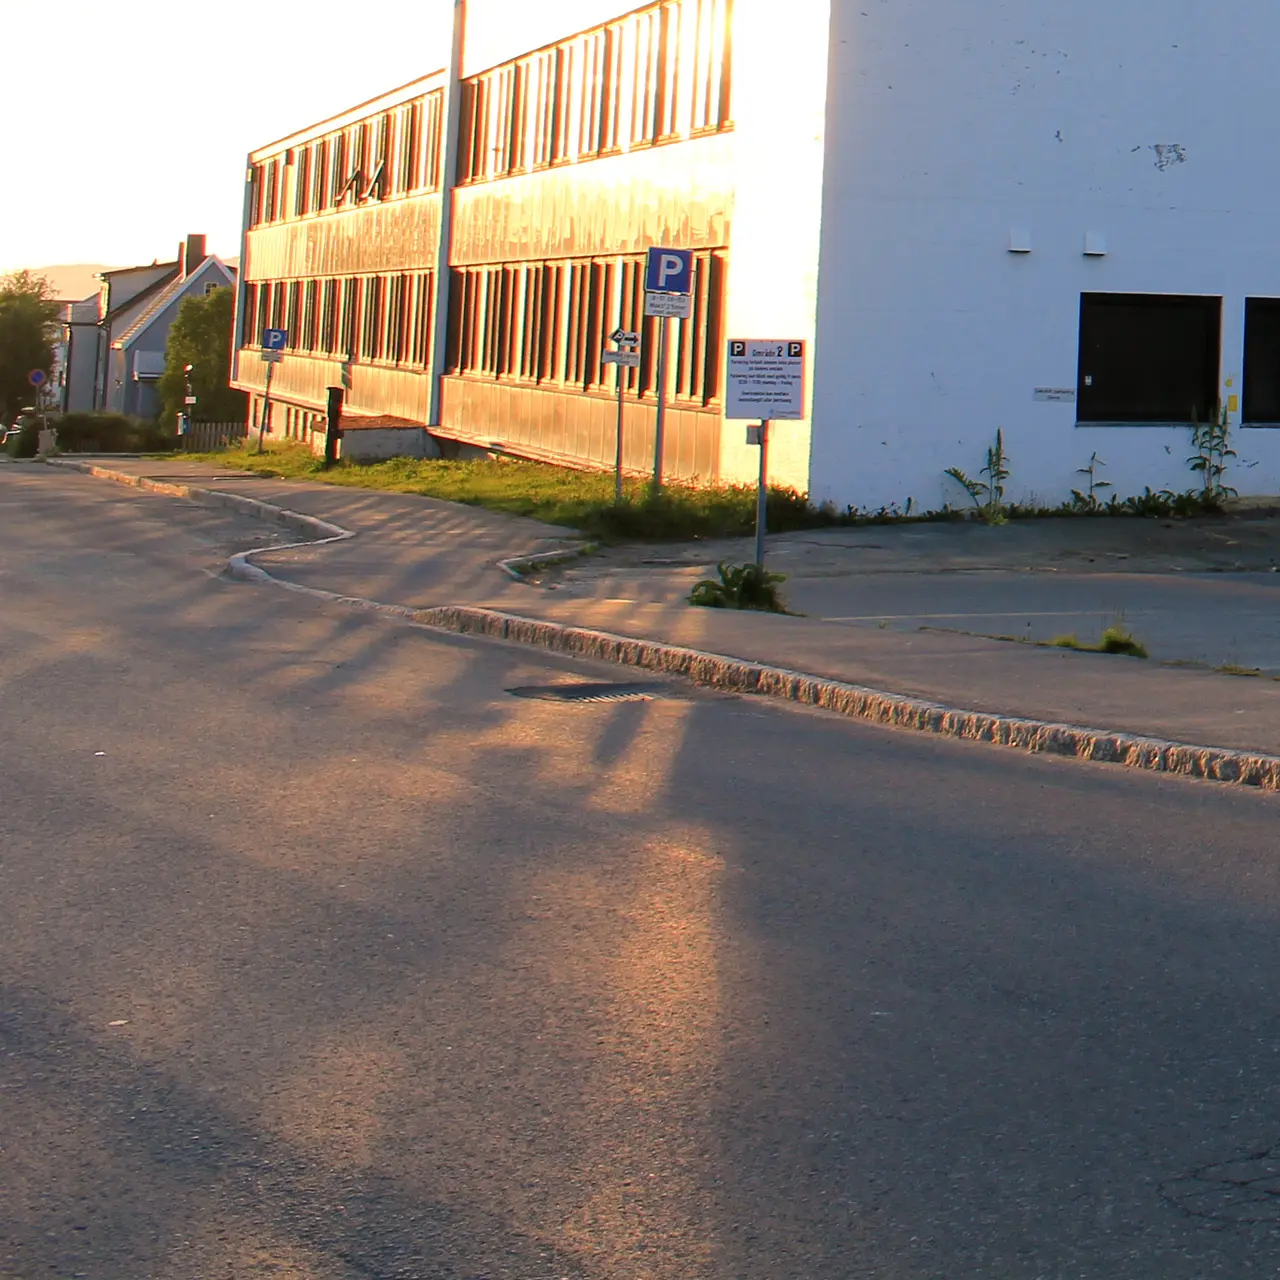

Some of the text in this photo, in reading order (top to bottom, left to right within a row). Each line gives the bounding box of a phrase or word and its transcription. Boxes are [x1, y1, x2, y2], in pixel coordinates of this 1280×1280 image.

[658, 254, 684, 287] P
[268, 331, 282, 347] P
[733, 342, 744, 355] P
[777, 345, 784, 358] 2
[790, 343, 801, 356] P
